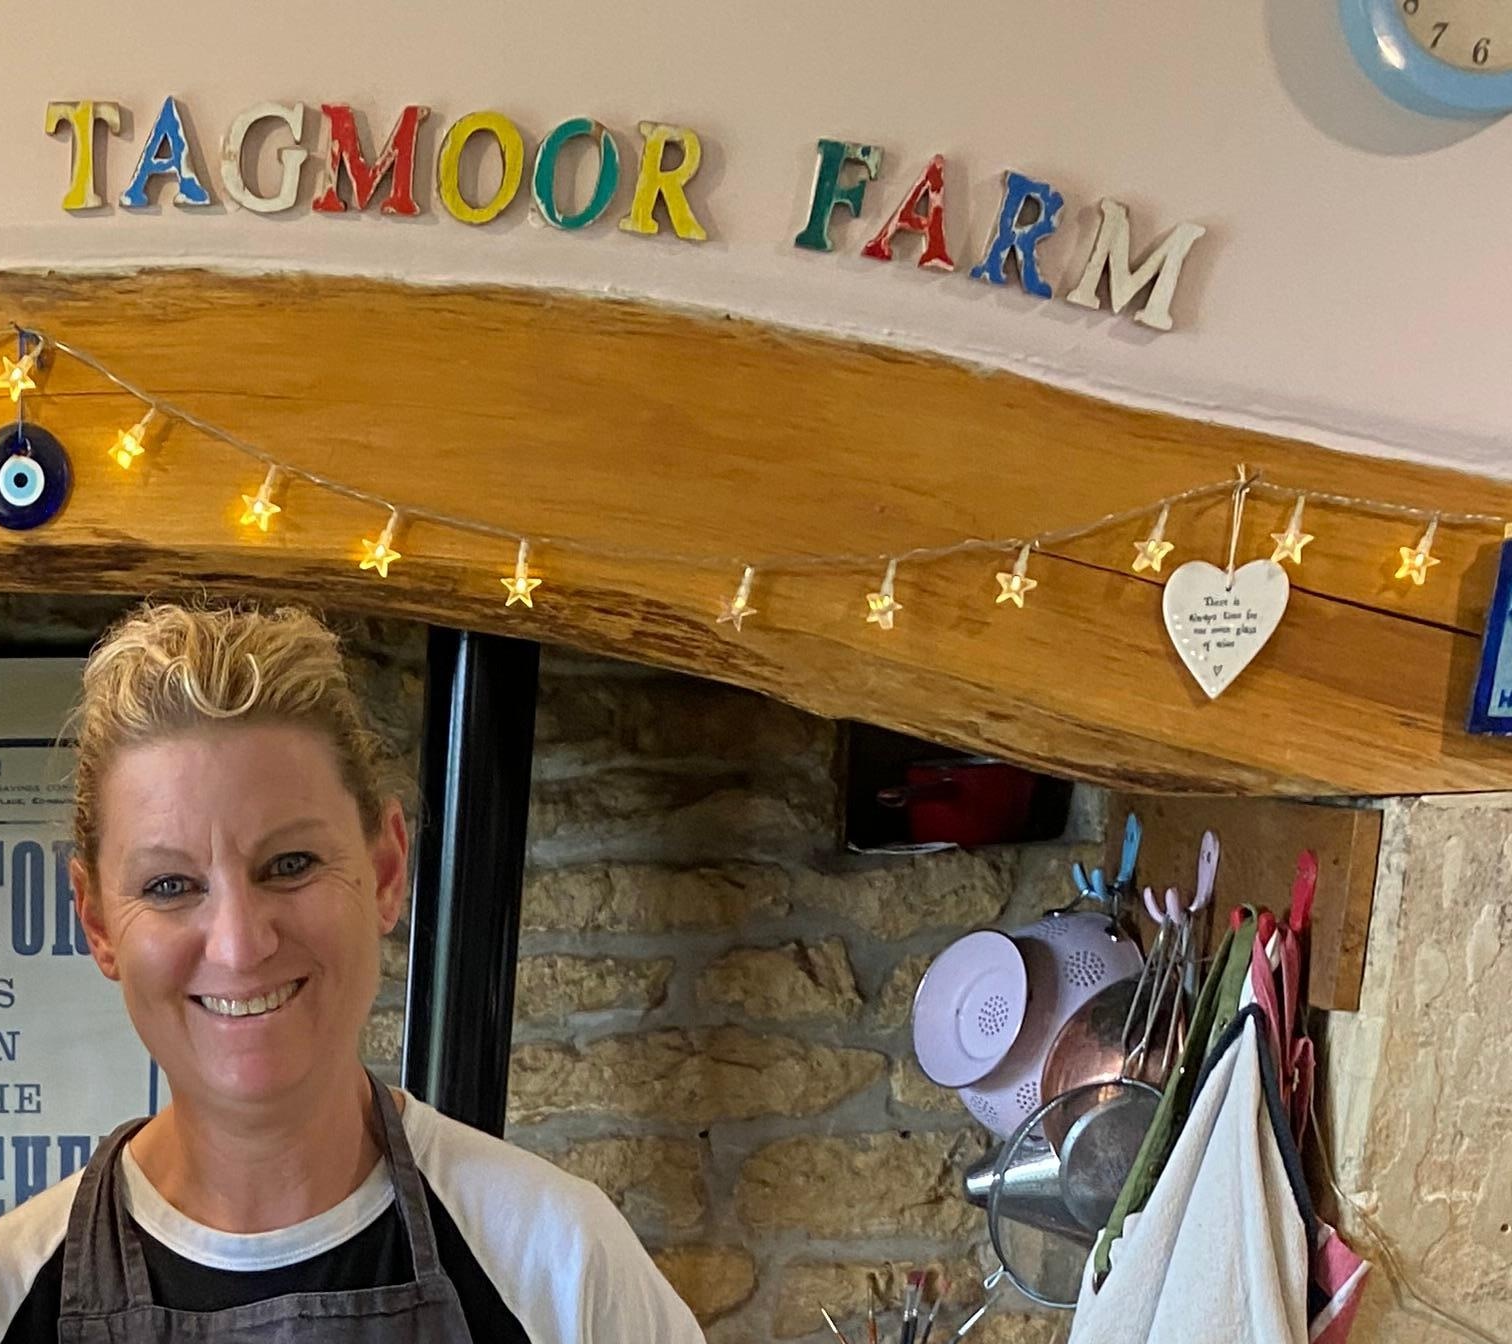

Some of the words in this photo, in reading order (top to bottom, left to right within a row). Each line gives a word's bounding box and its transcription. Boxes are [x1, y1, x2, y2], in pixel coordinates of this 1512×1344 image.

[1430, 22, 1449, 49] 7
[1472, 37, 1491, 65] 6
[45, 95, 709, 243] TAGMOOR
[794, 138, 1208, 332] FARM
